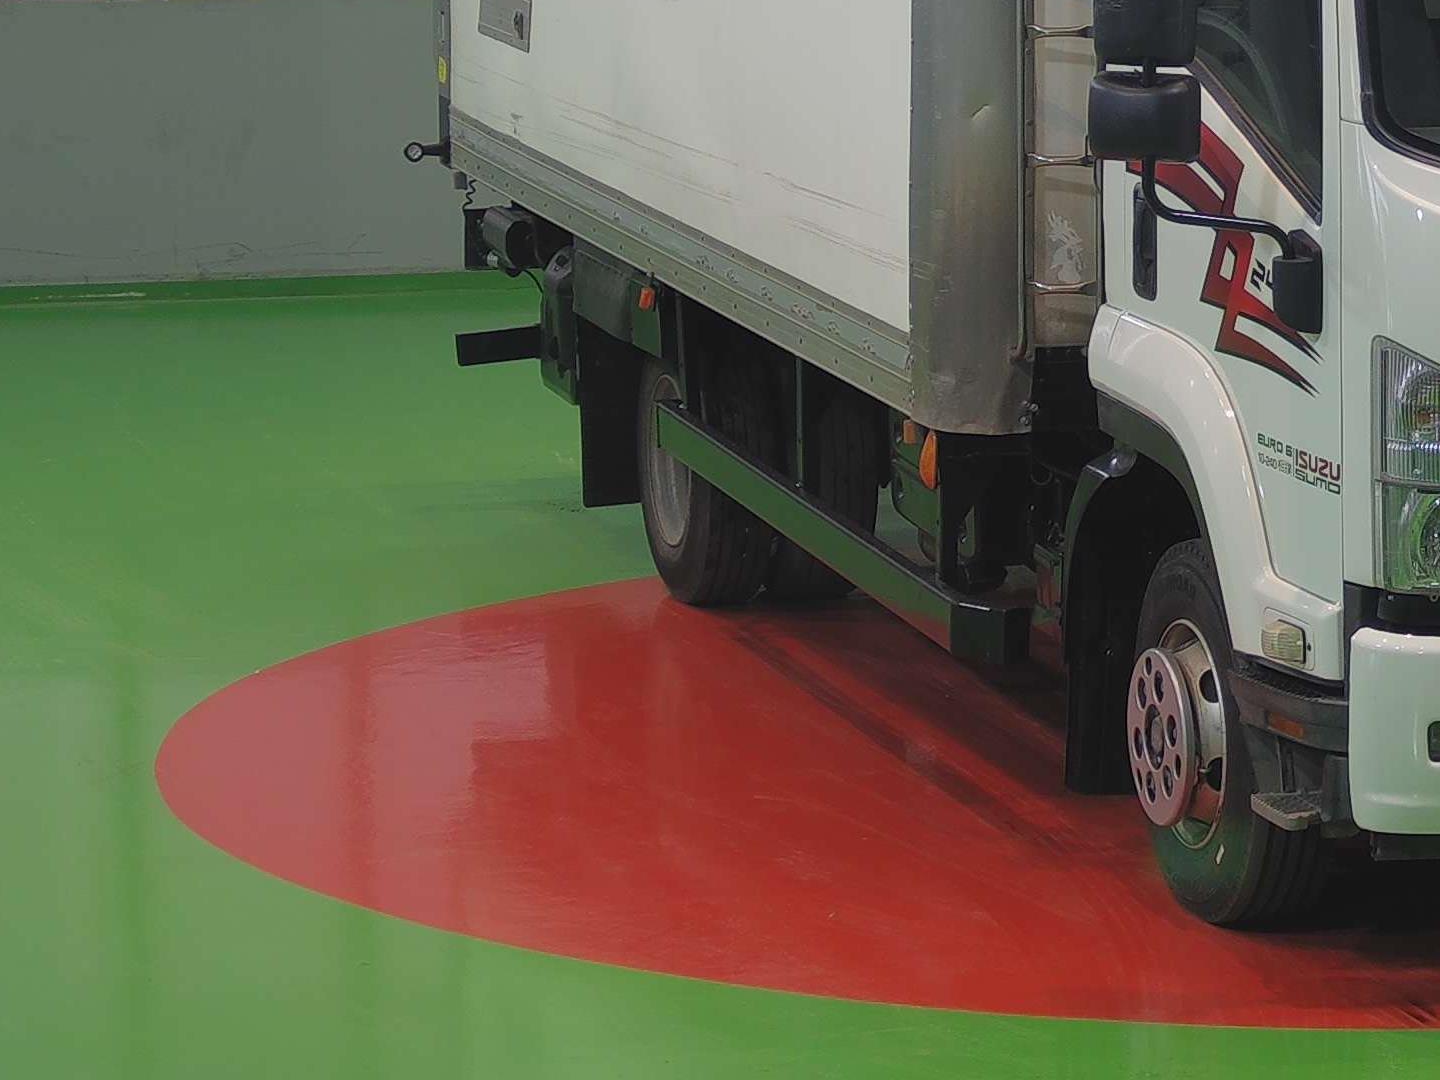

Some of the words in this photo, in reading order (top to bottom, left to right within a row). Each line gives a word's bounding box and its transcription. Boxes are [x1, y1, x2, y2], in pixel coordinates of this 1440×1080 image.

[1257, 432, 1283, 454] EURO
[1295, 448, 1341, 482] ISUZU
[1295, 468, 1341, 495] SUMO
